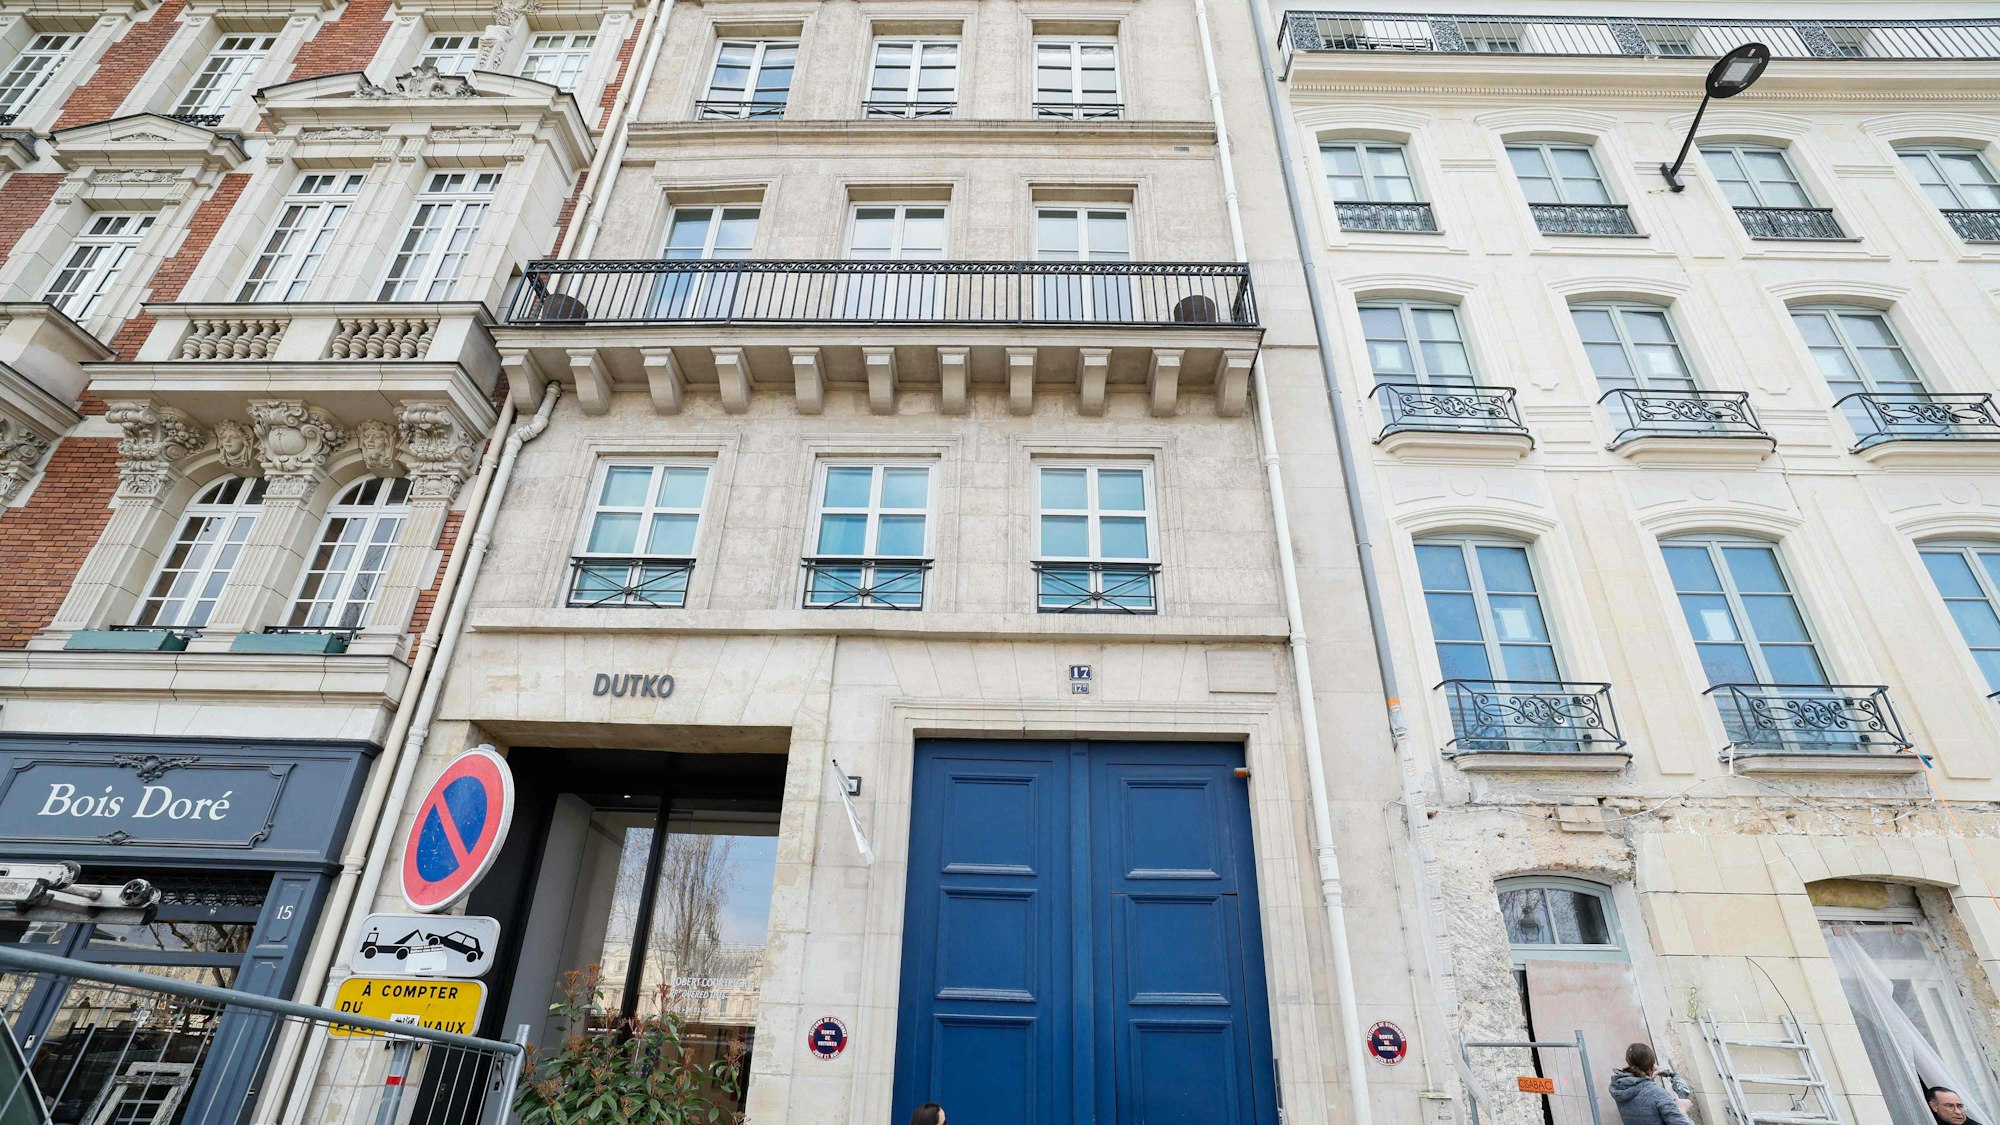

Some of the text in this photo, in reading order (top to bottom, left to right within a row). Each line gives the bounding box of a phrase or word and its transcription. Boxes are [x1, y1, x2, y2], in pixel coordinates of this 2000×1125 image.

[1073, 666, 1089, 678] 17
[592, 673, 675, 698] DUTKO
[37, 783, 233, 821] Bois Doré
[276, 905, 294, 920] 15
[362, 981, 458, 999] À COMPTER
[341, 1001, 363, 1013] DU
